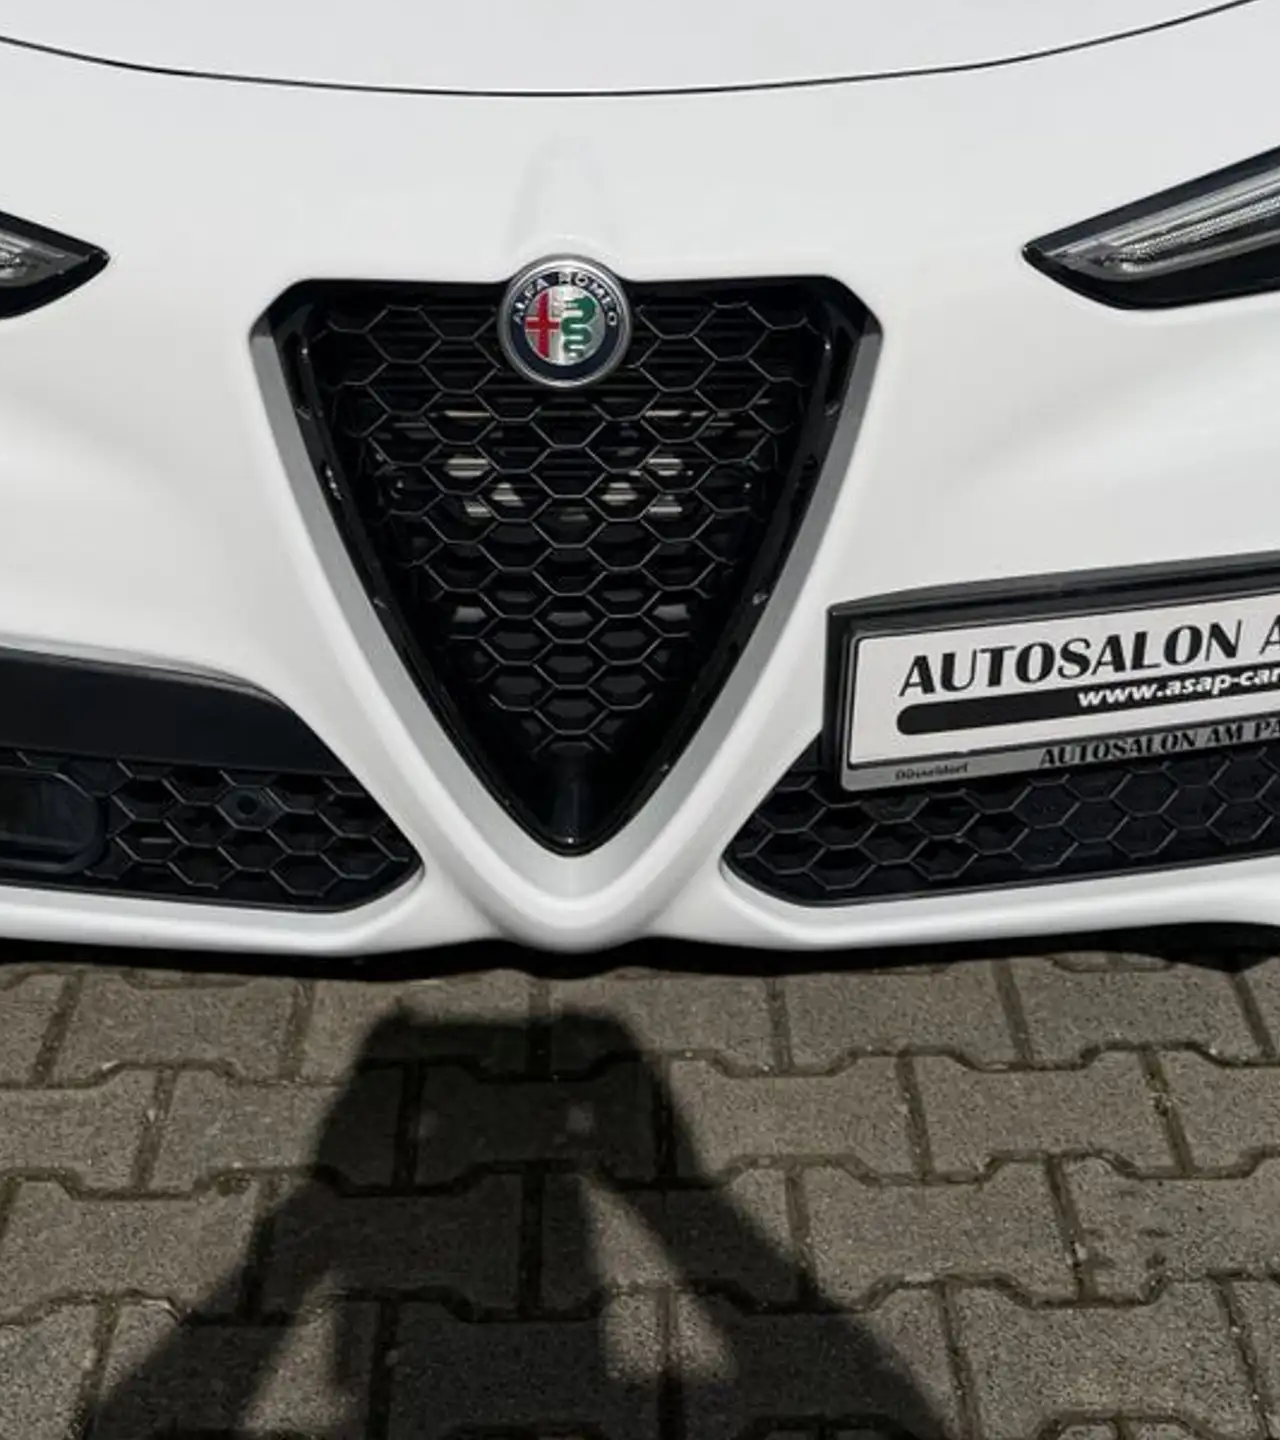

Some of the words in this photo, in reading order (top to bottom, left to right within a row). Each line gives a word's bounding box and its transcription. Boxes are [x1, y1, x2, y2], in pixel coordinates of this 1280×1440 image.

[899, 620, 1243, 697] AUTOSALON
[1038, 729, 1199, 768] AUTOSALON
[1206, 723, 1244, 744] AM
